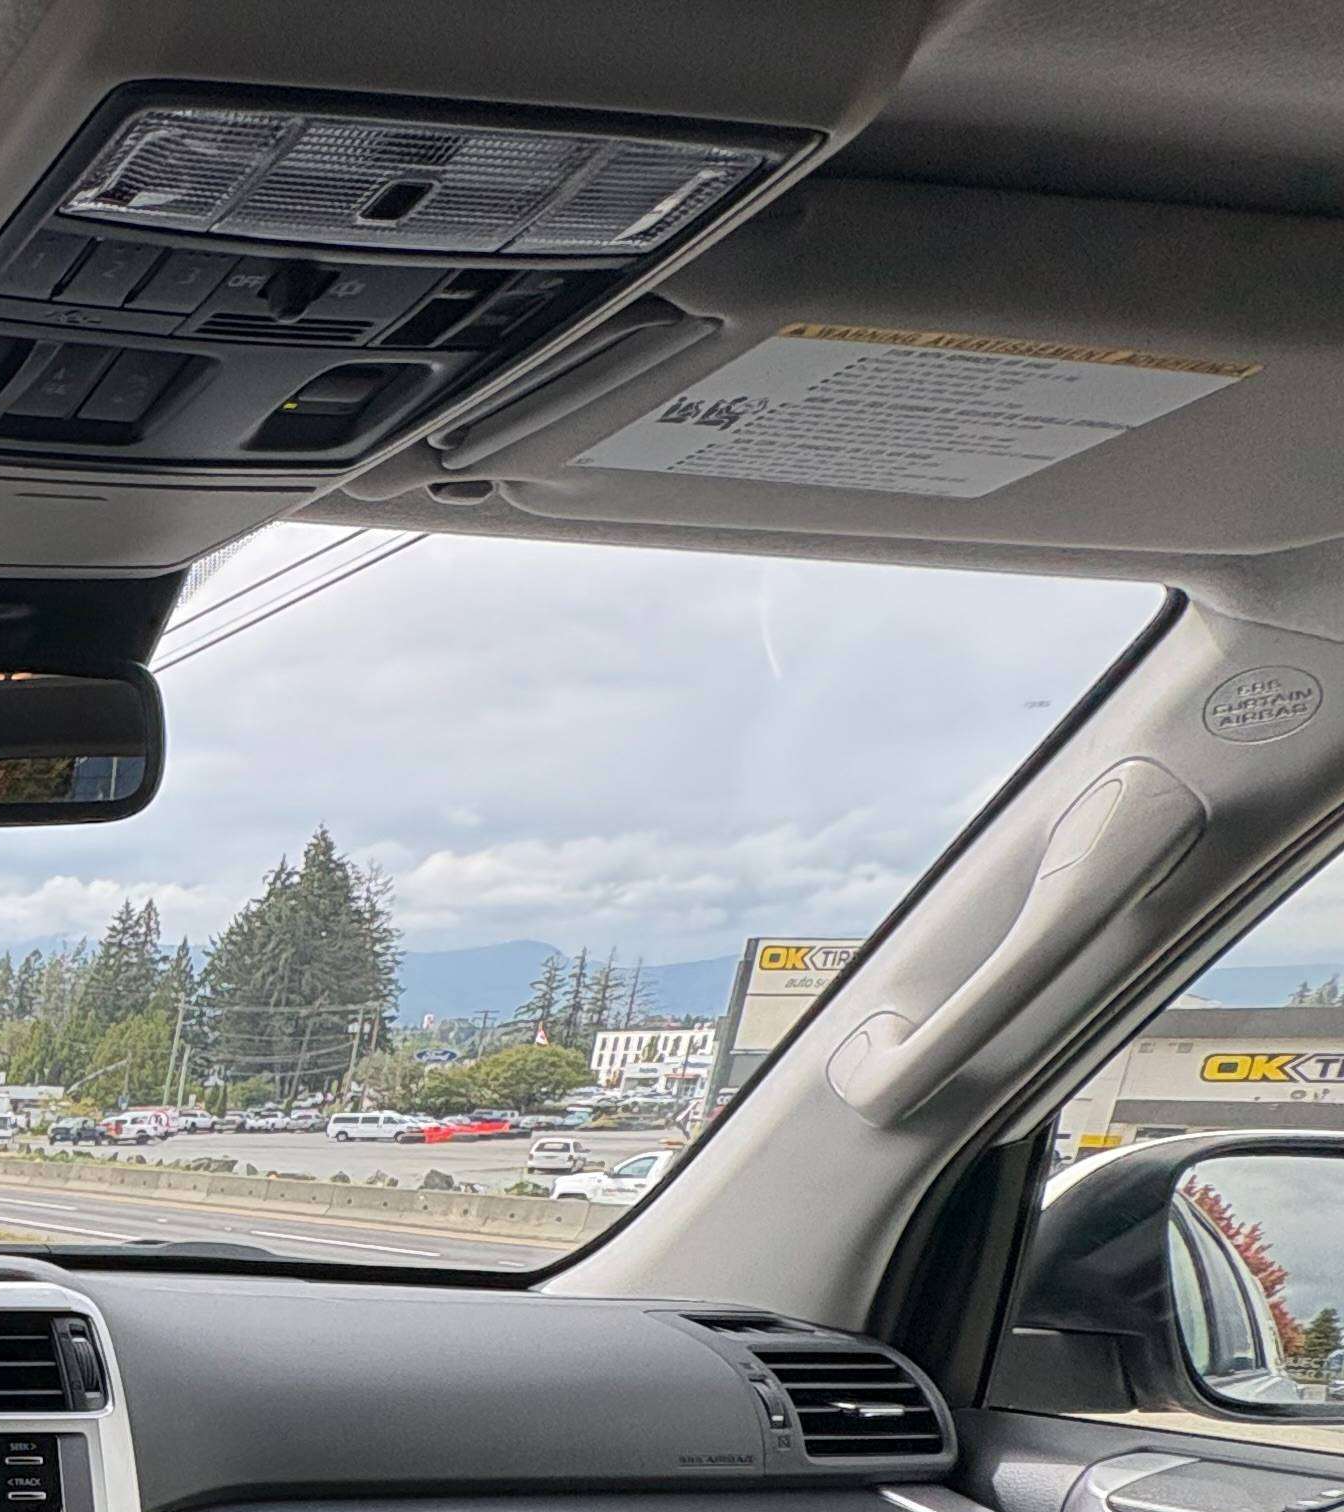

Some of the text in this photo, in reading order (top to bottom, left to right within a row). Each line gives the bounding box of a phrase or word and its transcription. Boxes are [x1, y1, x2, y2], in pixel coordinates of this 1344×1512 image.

[227, 274, 263, 289] OFF
[1219, 703, 1308, 728] AIRBAG
[759, 946, 814, 970] OK
[784, 975, 812, 989] auto
[1201, 1053, 1300, 1083] OK
[14, 1477, 41, 1486] TRACK
